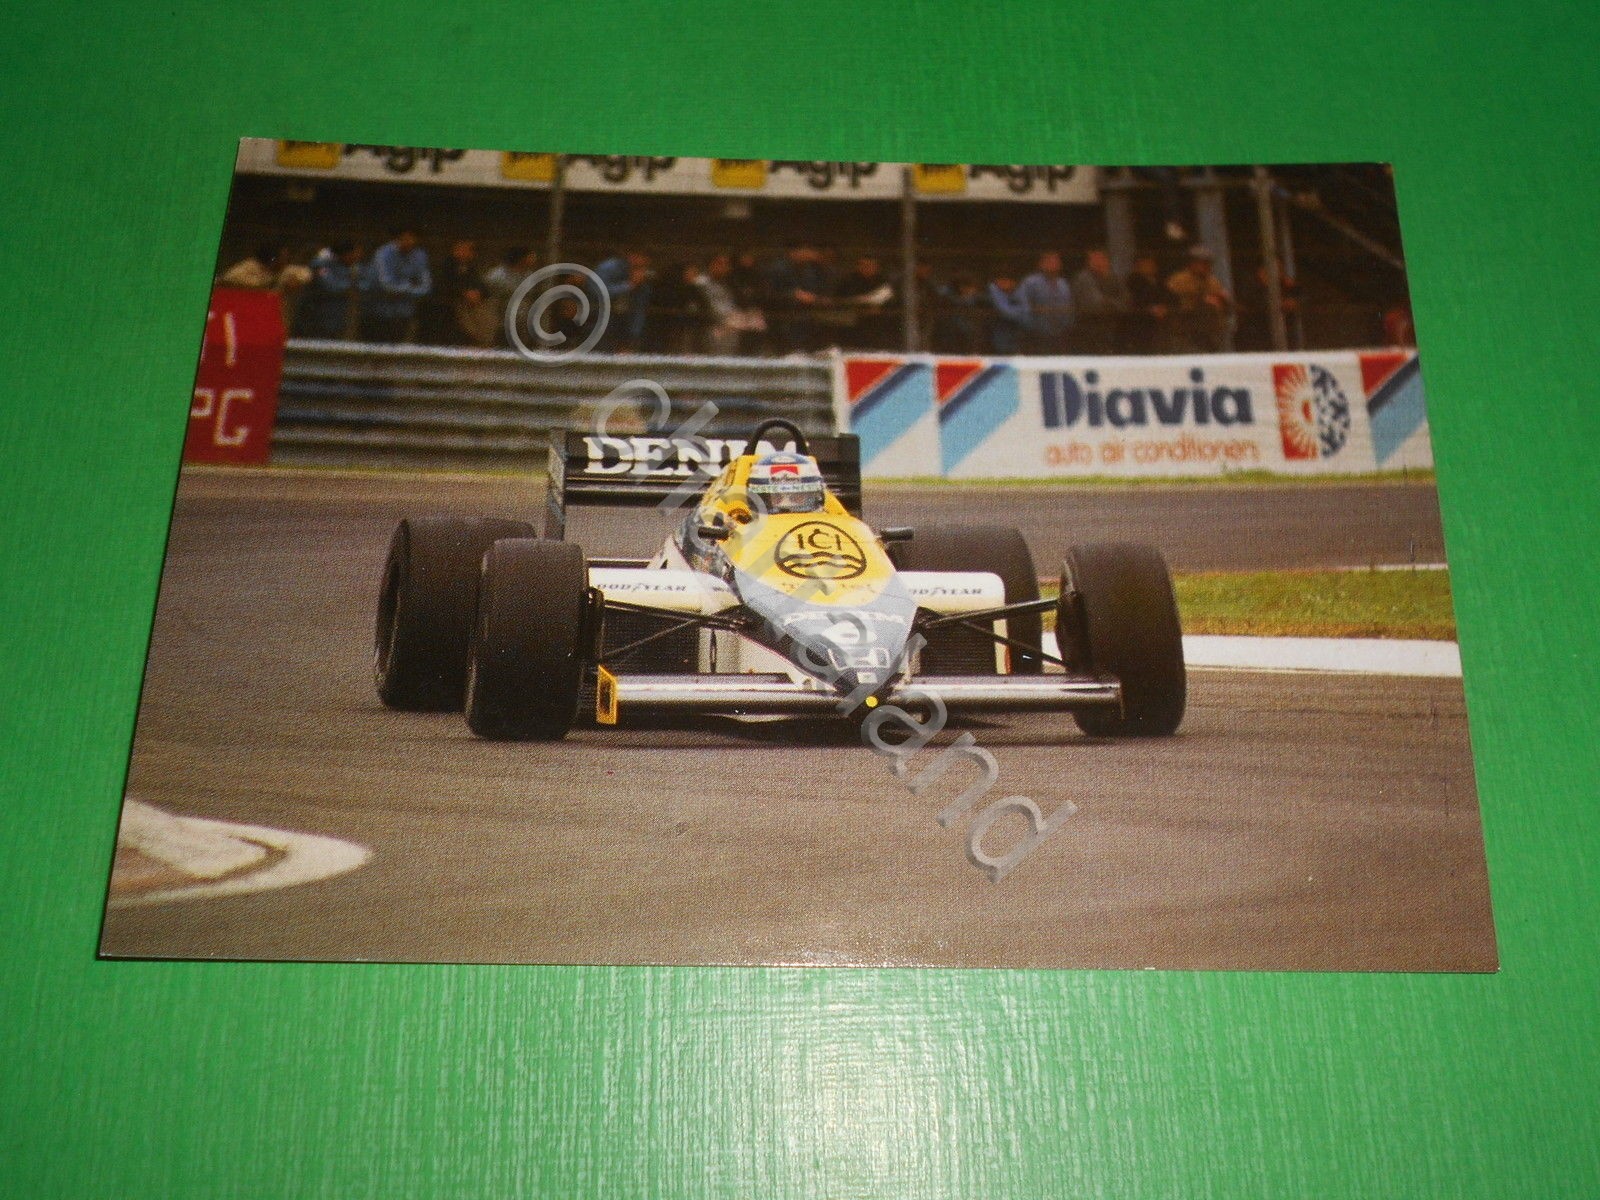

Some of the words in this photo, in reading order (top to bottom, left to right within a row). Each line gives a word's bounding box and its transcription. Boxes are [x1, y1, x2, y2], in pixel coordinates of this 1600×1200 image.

[1039, 368, 1253, 430] Diavia
[1043, 441, 1094, 467] auto
[797, 527, 842, 551] ICI
